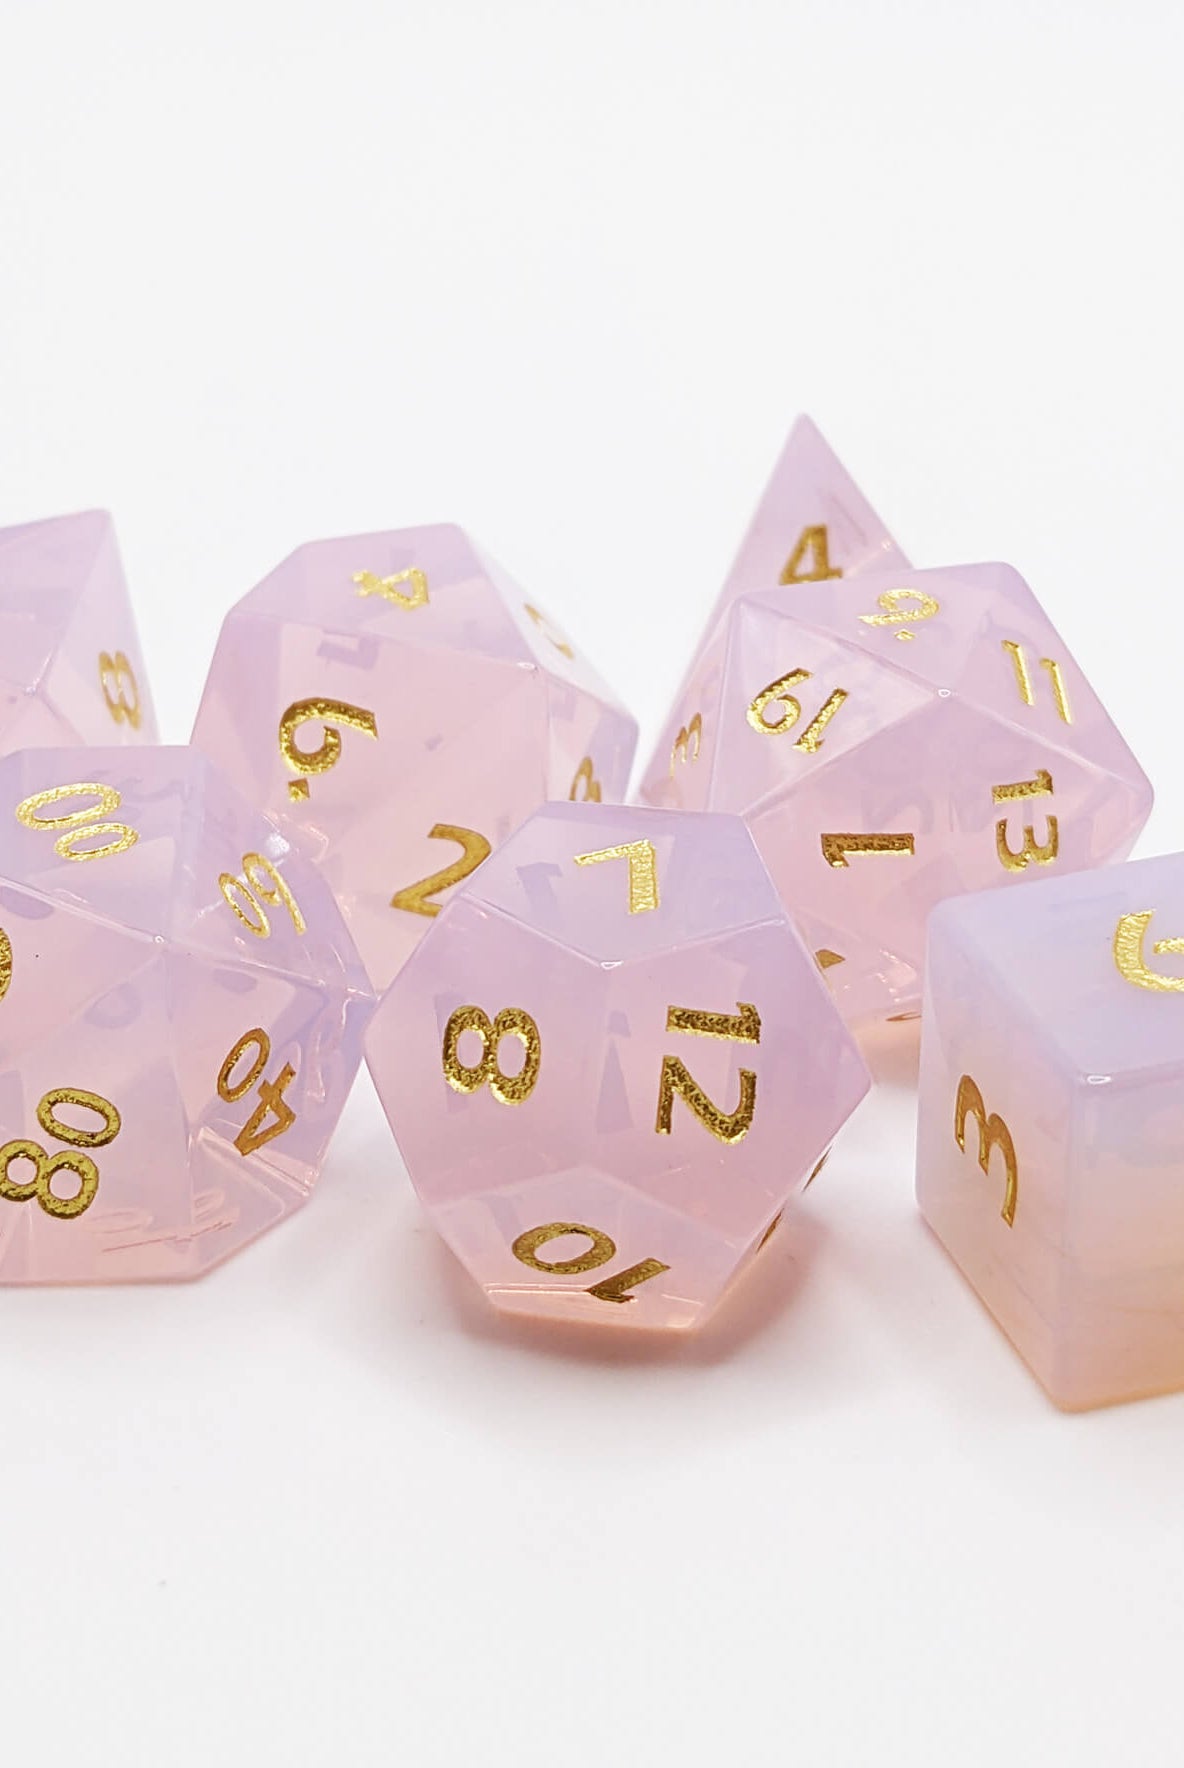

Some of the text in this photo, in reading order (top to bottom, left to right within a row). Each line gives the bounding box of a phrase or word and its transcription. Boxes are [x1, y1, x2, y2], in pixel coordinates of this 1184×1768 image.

[352, 567, 431, 611] 4
[780, 523, 843, 586] 4
[1000, 639, 1071, 724] 11
[671, 713, 703, 778] 3
[15, 782, 139, 861] 00
[820, 832, 916, 869] 1
[992, 769, 1060, 873] 13
[389, 823, 493, 918] 2
[573, 839, 661, 915] 7
[216, 1027, 297, 1157] 40
[442, 1005, 542, 1107] 8
[654, 1001, 762, 1147] 12
[0, 1087, 122, 1221] 80
[953, 1074, 1022, 1230] 3
[511, 1221, 672, 1304] 10
